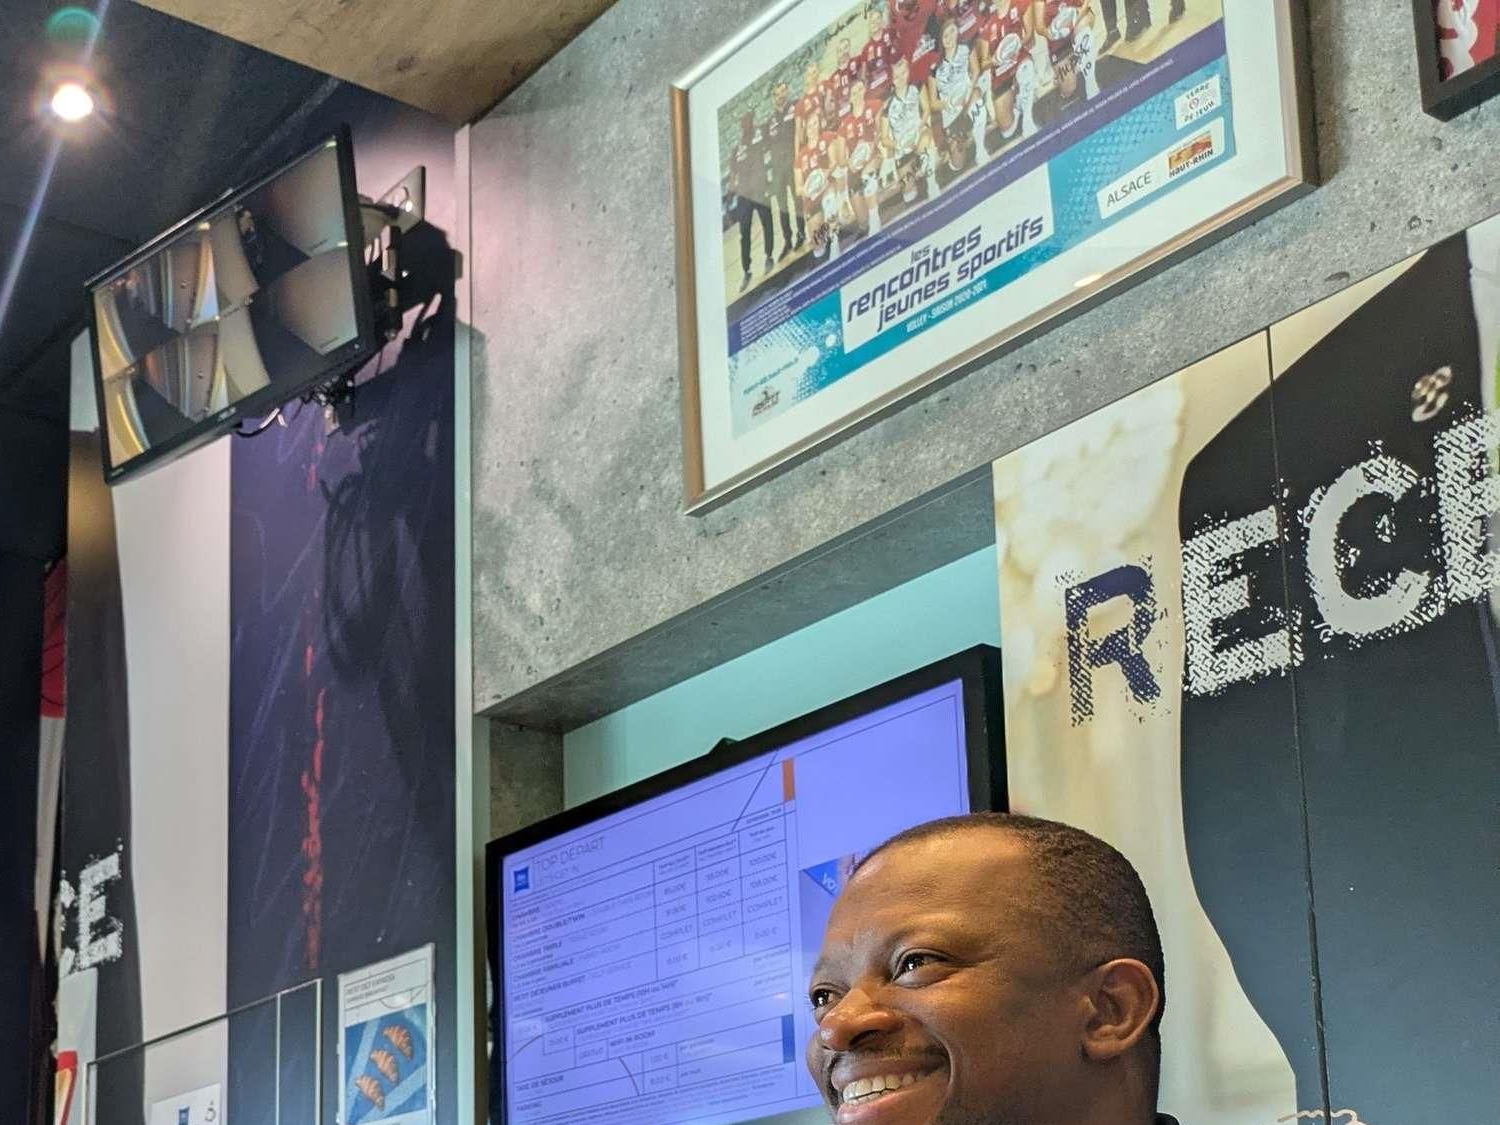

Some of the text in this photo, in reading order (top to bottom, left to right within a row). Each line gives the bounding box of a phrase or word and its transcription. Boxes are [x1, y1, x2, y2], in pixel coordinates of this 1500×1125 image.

[1107, 171, 1152, 207] ALSACE
[847, 226, 982, 322] rencontres
[878, 216, 1044, 331] jeunes sportifs
[911, 246, 930, 264] les
